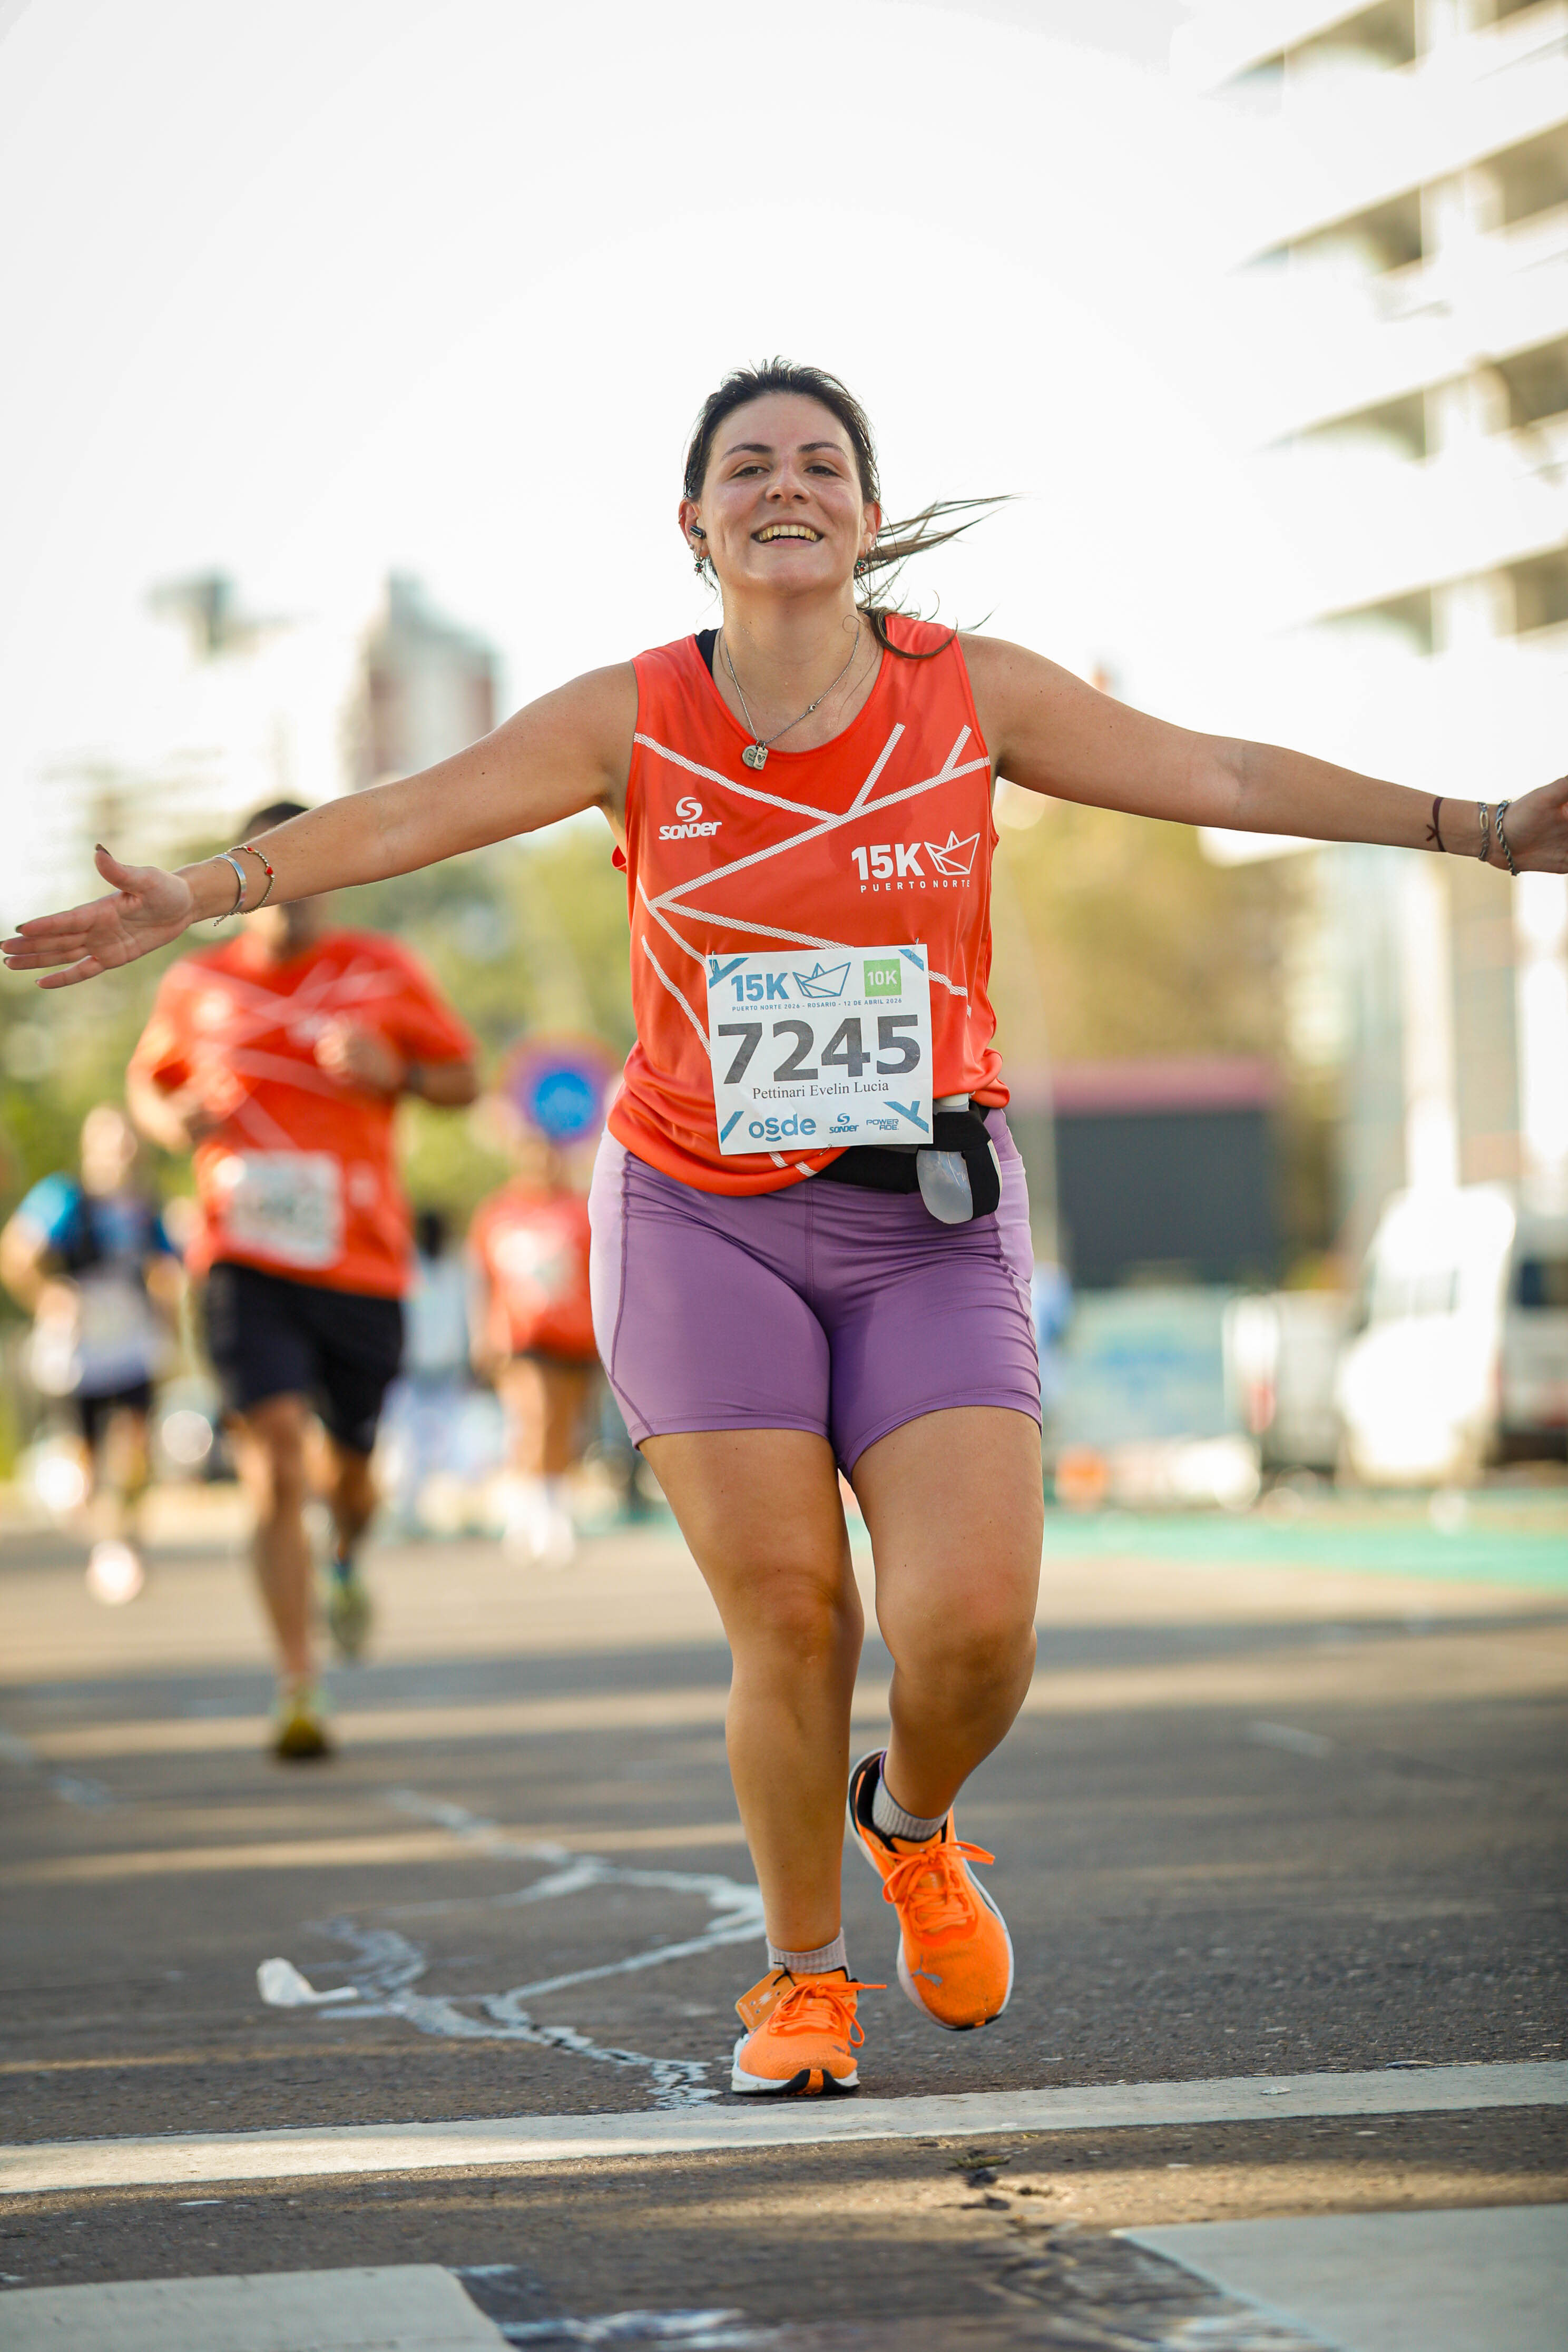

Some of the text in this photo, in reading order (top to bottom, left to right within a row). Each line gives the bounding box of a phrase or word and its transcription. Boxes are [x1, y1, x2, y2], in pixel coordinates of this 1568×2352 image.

[851, 843, 925, 880] 15K
[860, 881, 926, 893] PUERTO
[731, 973, 790, 1002] 15K
[867, 969, 898, 986] 10K
[718, 1015, 920, 1084] 7245
[752, 1080, 889, 1099] Pettinari Evelin Lucia
[749, 1113, 817, 1139] osde
